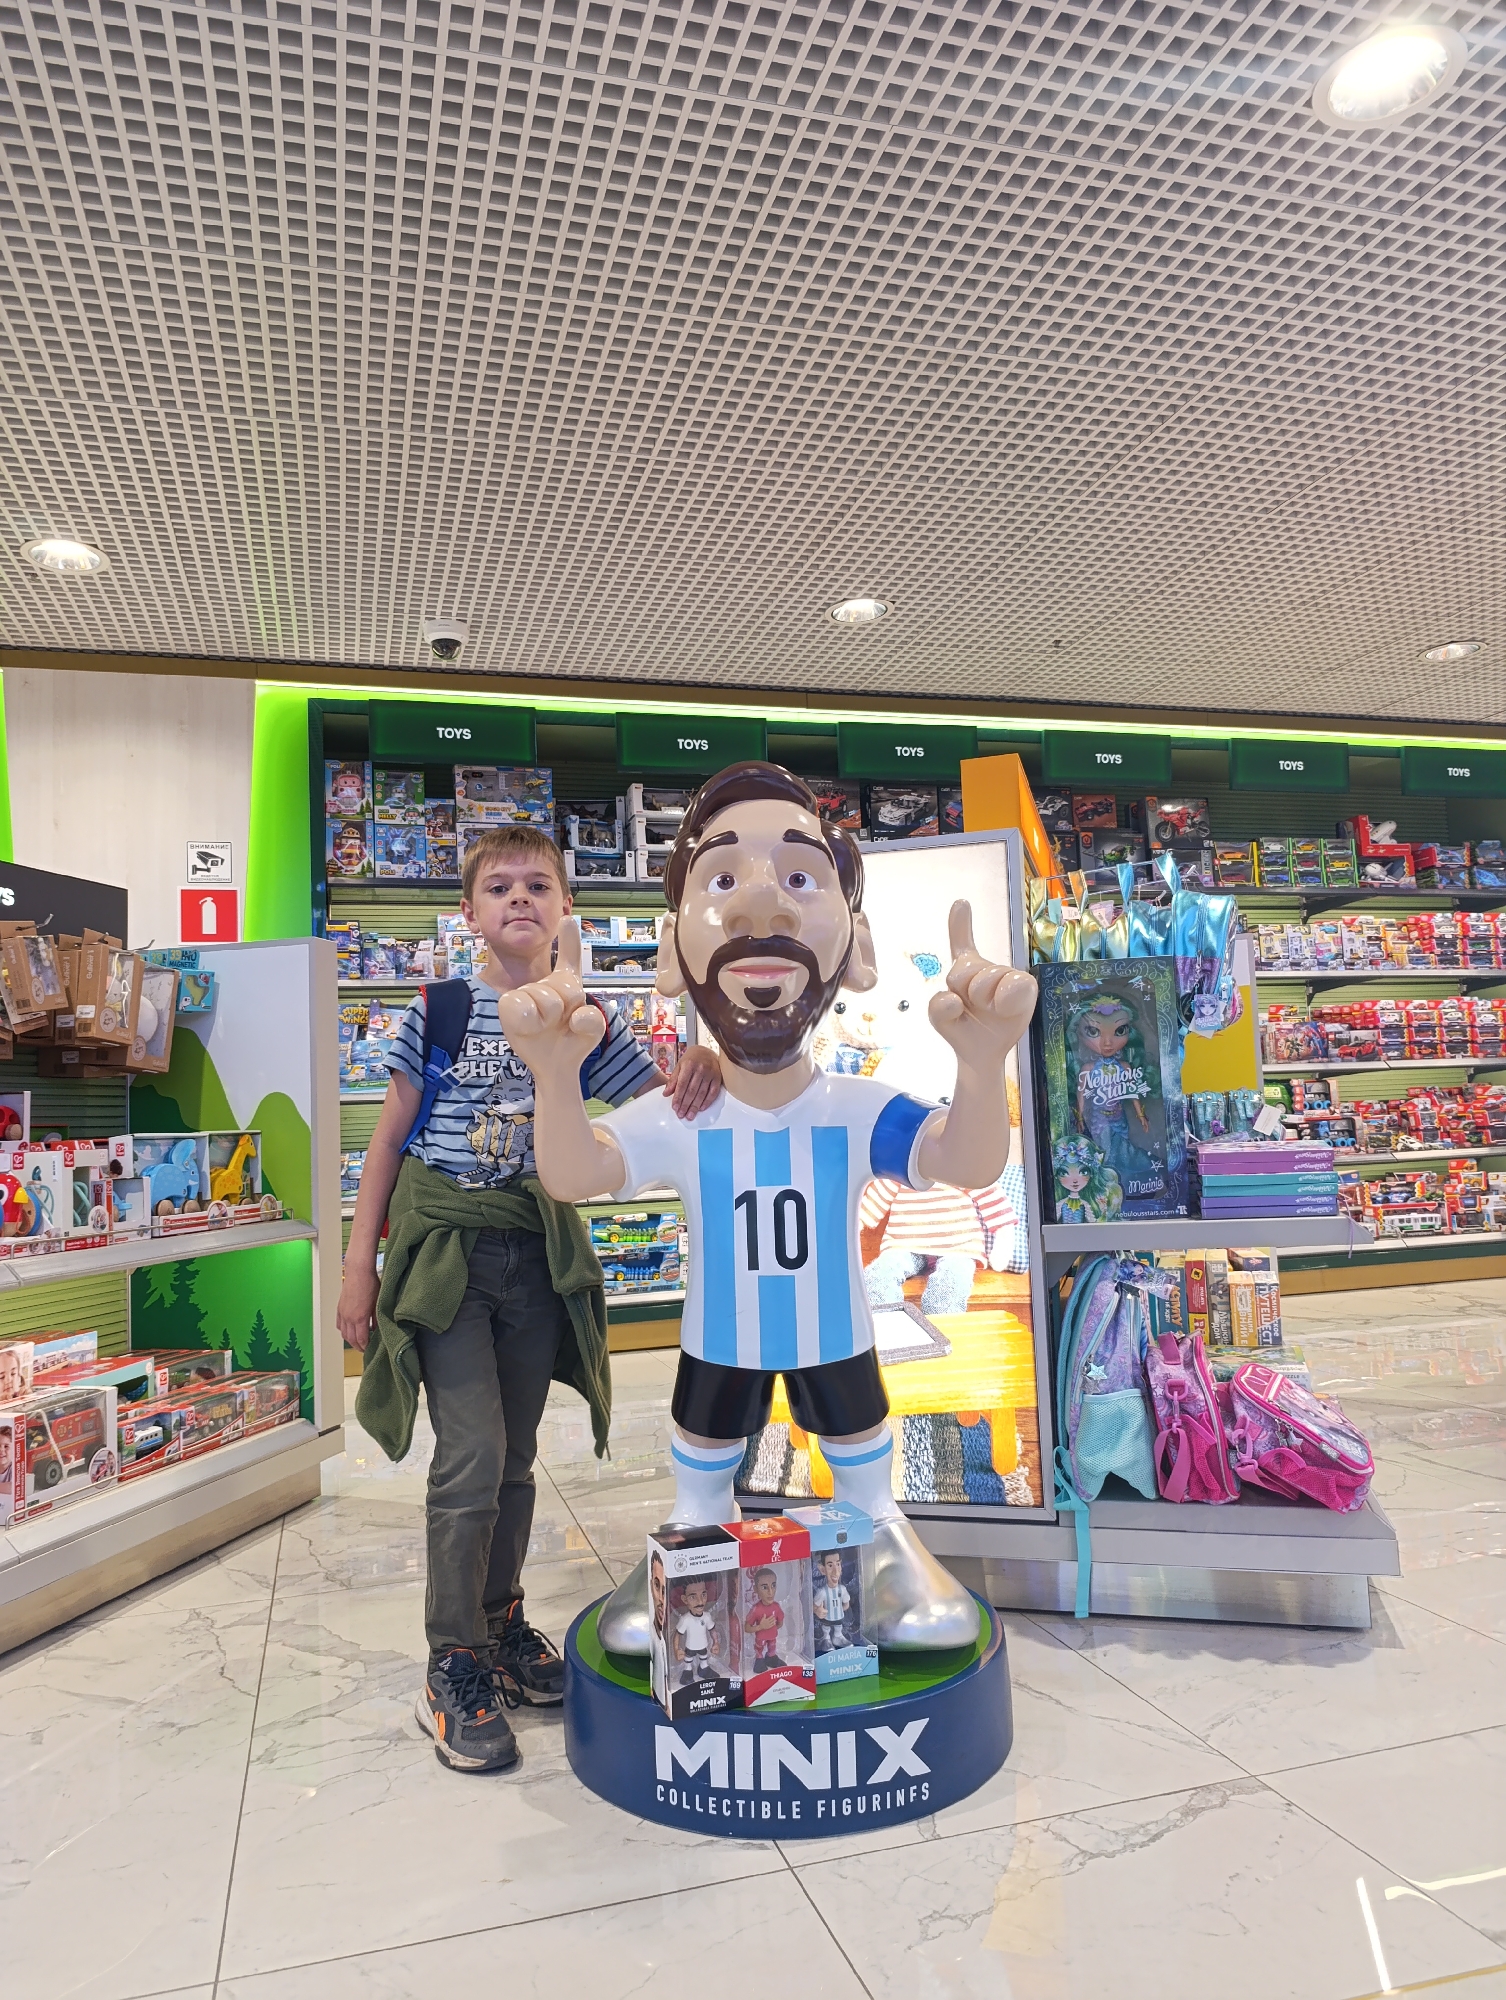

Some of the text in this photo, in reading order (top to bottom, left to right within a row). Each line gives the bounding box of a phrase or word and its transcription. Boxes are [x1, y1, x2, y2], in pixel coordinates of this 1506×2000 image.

[436, 727, 472, 741] TOYS
[677, 738, 709, 751] TOYS
[894, 746, 925, 758] TOYS
[1095, 753, 1123, 765] TOYS
[1279, 760, 1304, 772] TOYS
[1446, 767, 1471, 778] TOYS
[86, 952, 95, 980] Gulliver
[169, 961, 196, 969] MAGNETIC
[342, 1006, 369, 1017] SUPER
[466, 1037, 517, 1056] EXP
[1078, 1066, 1143, 1091] Nebulous
[1093, 1080, 1139, 1106] Stars
[1128, 1176, 1165, 1194] Marinia
[1115, 1208, 1175, 1218] nebulousstars.com
[735, 1188, 809, 1271] 10
[1259, 1285, 1273, 1346] ПУТЕШЕСТ
[1270, 1285, 1280, 1337] Космическое
[1211, 1322, 1221, 1339] дом
[828, 1650, 862, 1665] DI MARÍA
[770, 1670, 793, 1680] THIAGO
[802, 1669, 814, 1677] 138
[829, 1662, 863, 1676] MINIX
[699, 1681, 716, 1689] LEROY
[729, 1681, 741, 1689] 169
[689, 1695, 726, 1710] MINIX
[655, 1717, 931, 1790] MINIX
[656, 1784, 801, 1819] COLLECTIBLE
